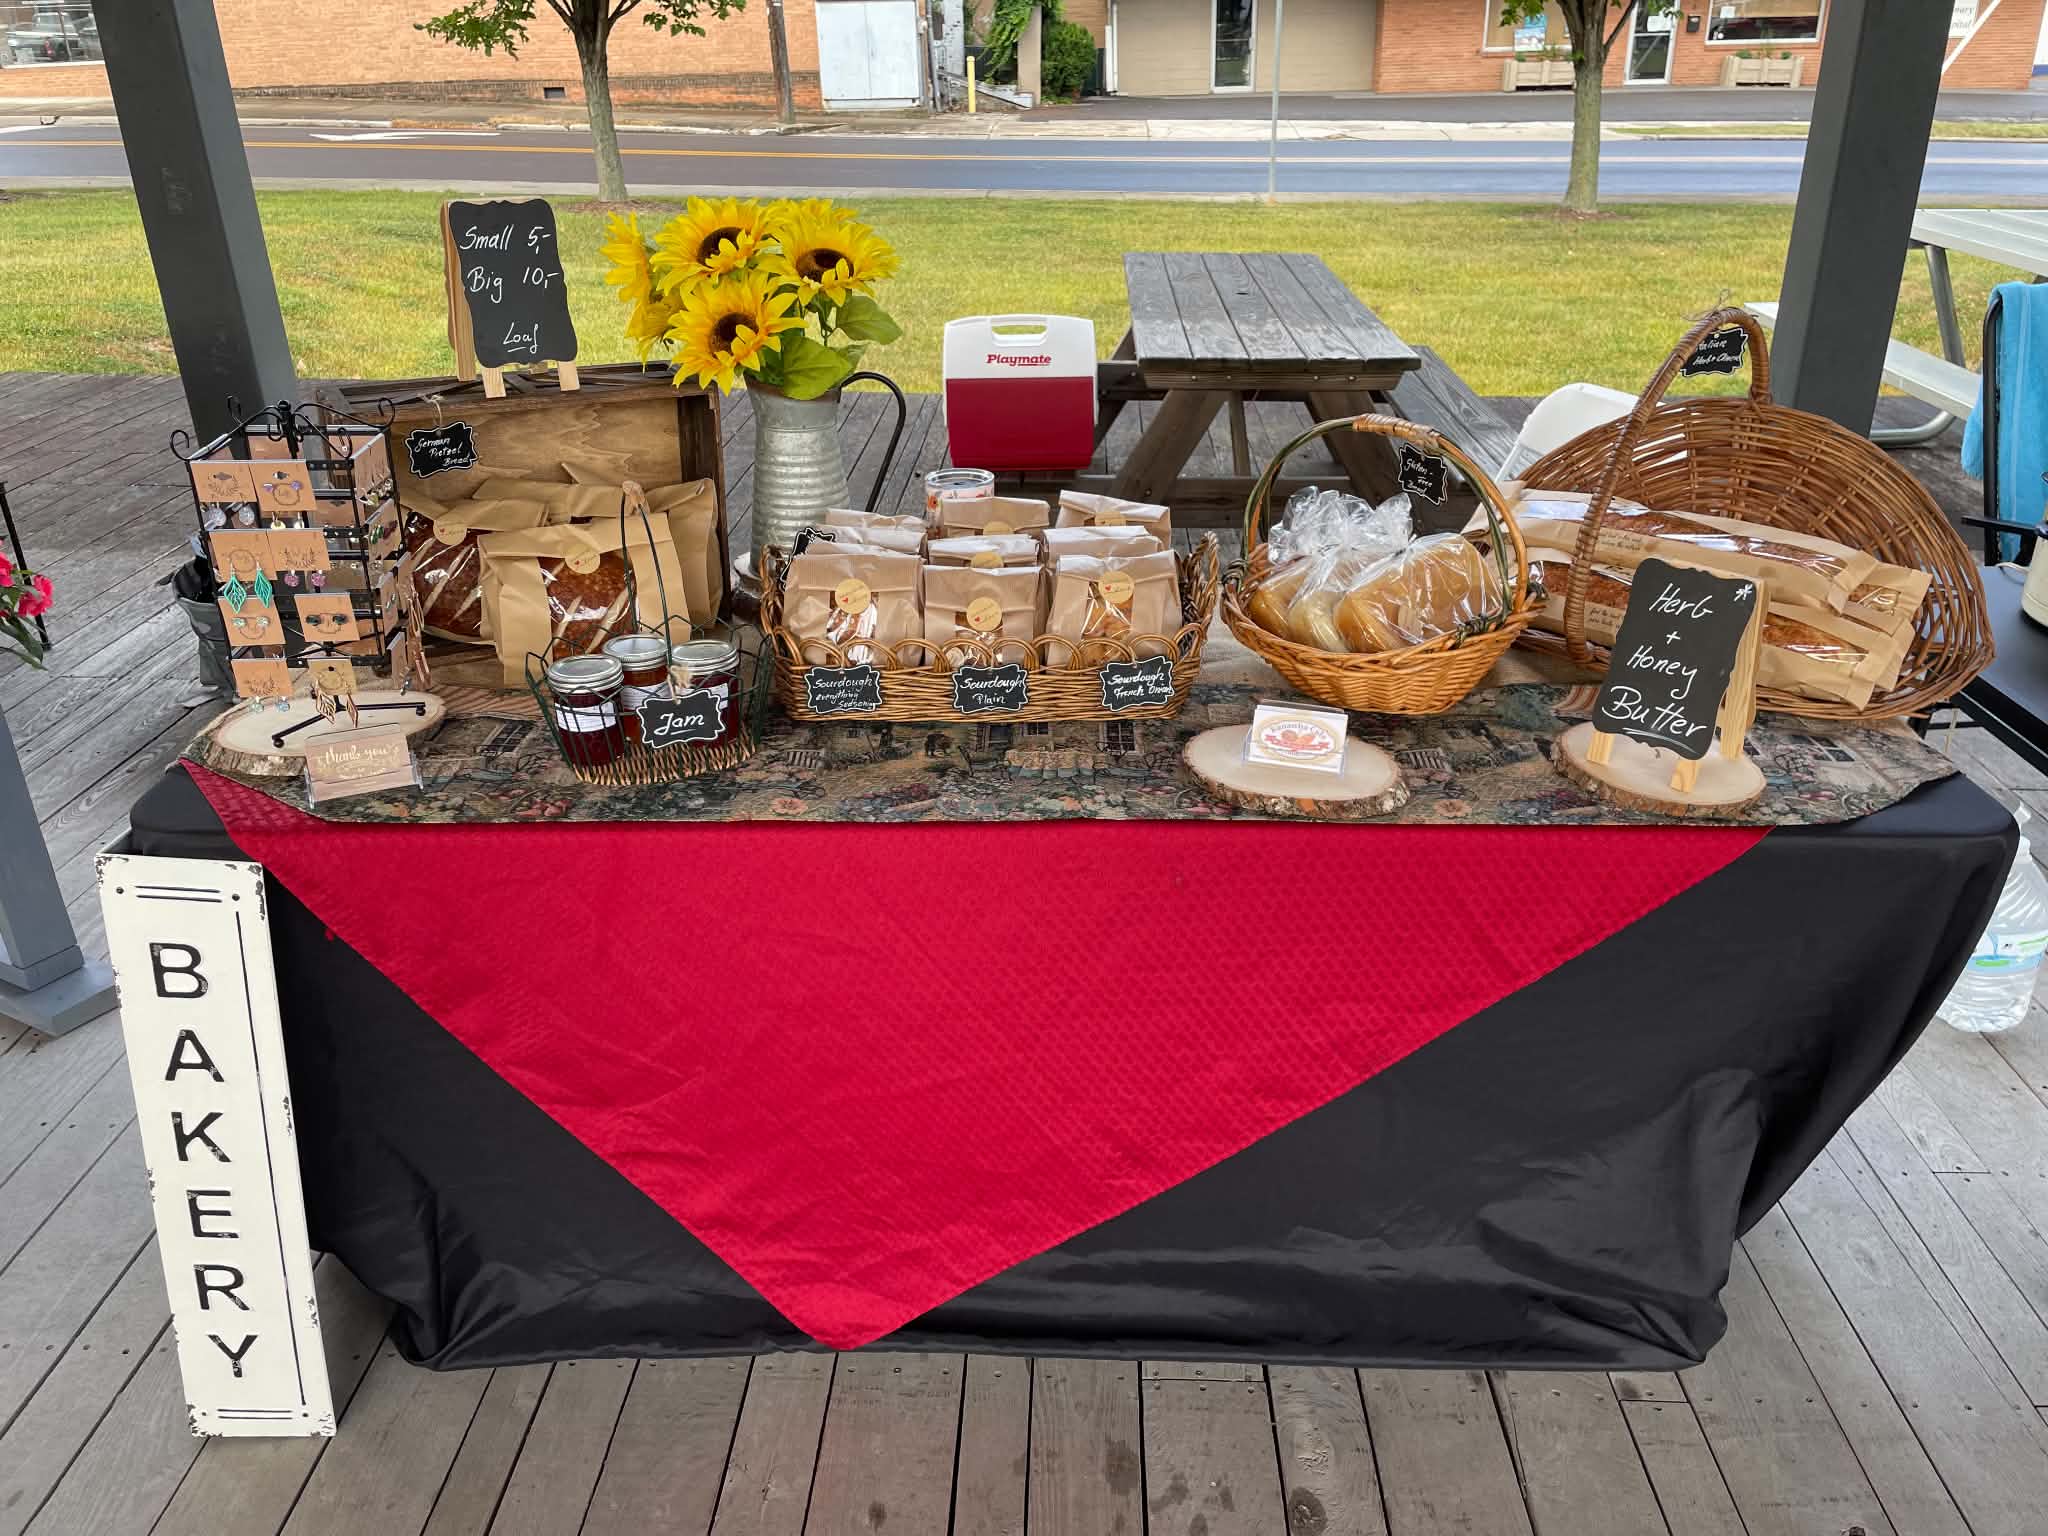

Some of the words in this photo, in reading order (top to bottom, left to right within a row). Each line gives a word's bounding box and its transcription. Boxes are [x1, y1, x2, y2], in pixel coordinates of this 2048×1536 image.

[459, 224, 515, 250] Small
[467, 266, 503, 304] Big
[503, 322, 539, 354] Loaf
[986, 353, 1052, 367] Playmate
[414, 438, 451, 453] German
[1648, 582, 1713, 619] Herb
[812, 674, 873, 692] Sourdough
[960, 674, 1022, 693] Sourdough
[1107, 666, 1164, 686] Sourdough
[1626, 645, 1698, 699] Honey
[972, 692, 1006, 705] Plain
[1113, 684, 1145, 699] French
[653, 711, 704, 735] Jam
[1601, 686, 1707, 737] Butter
[148, 941, 259, 1379] BAKERY
